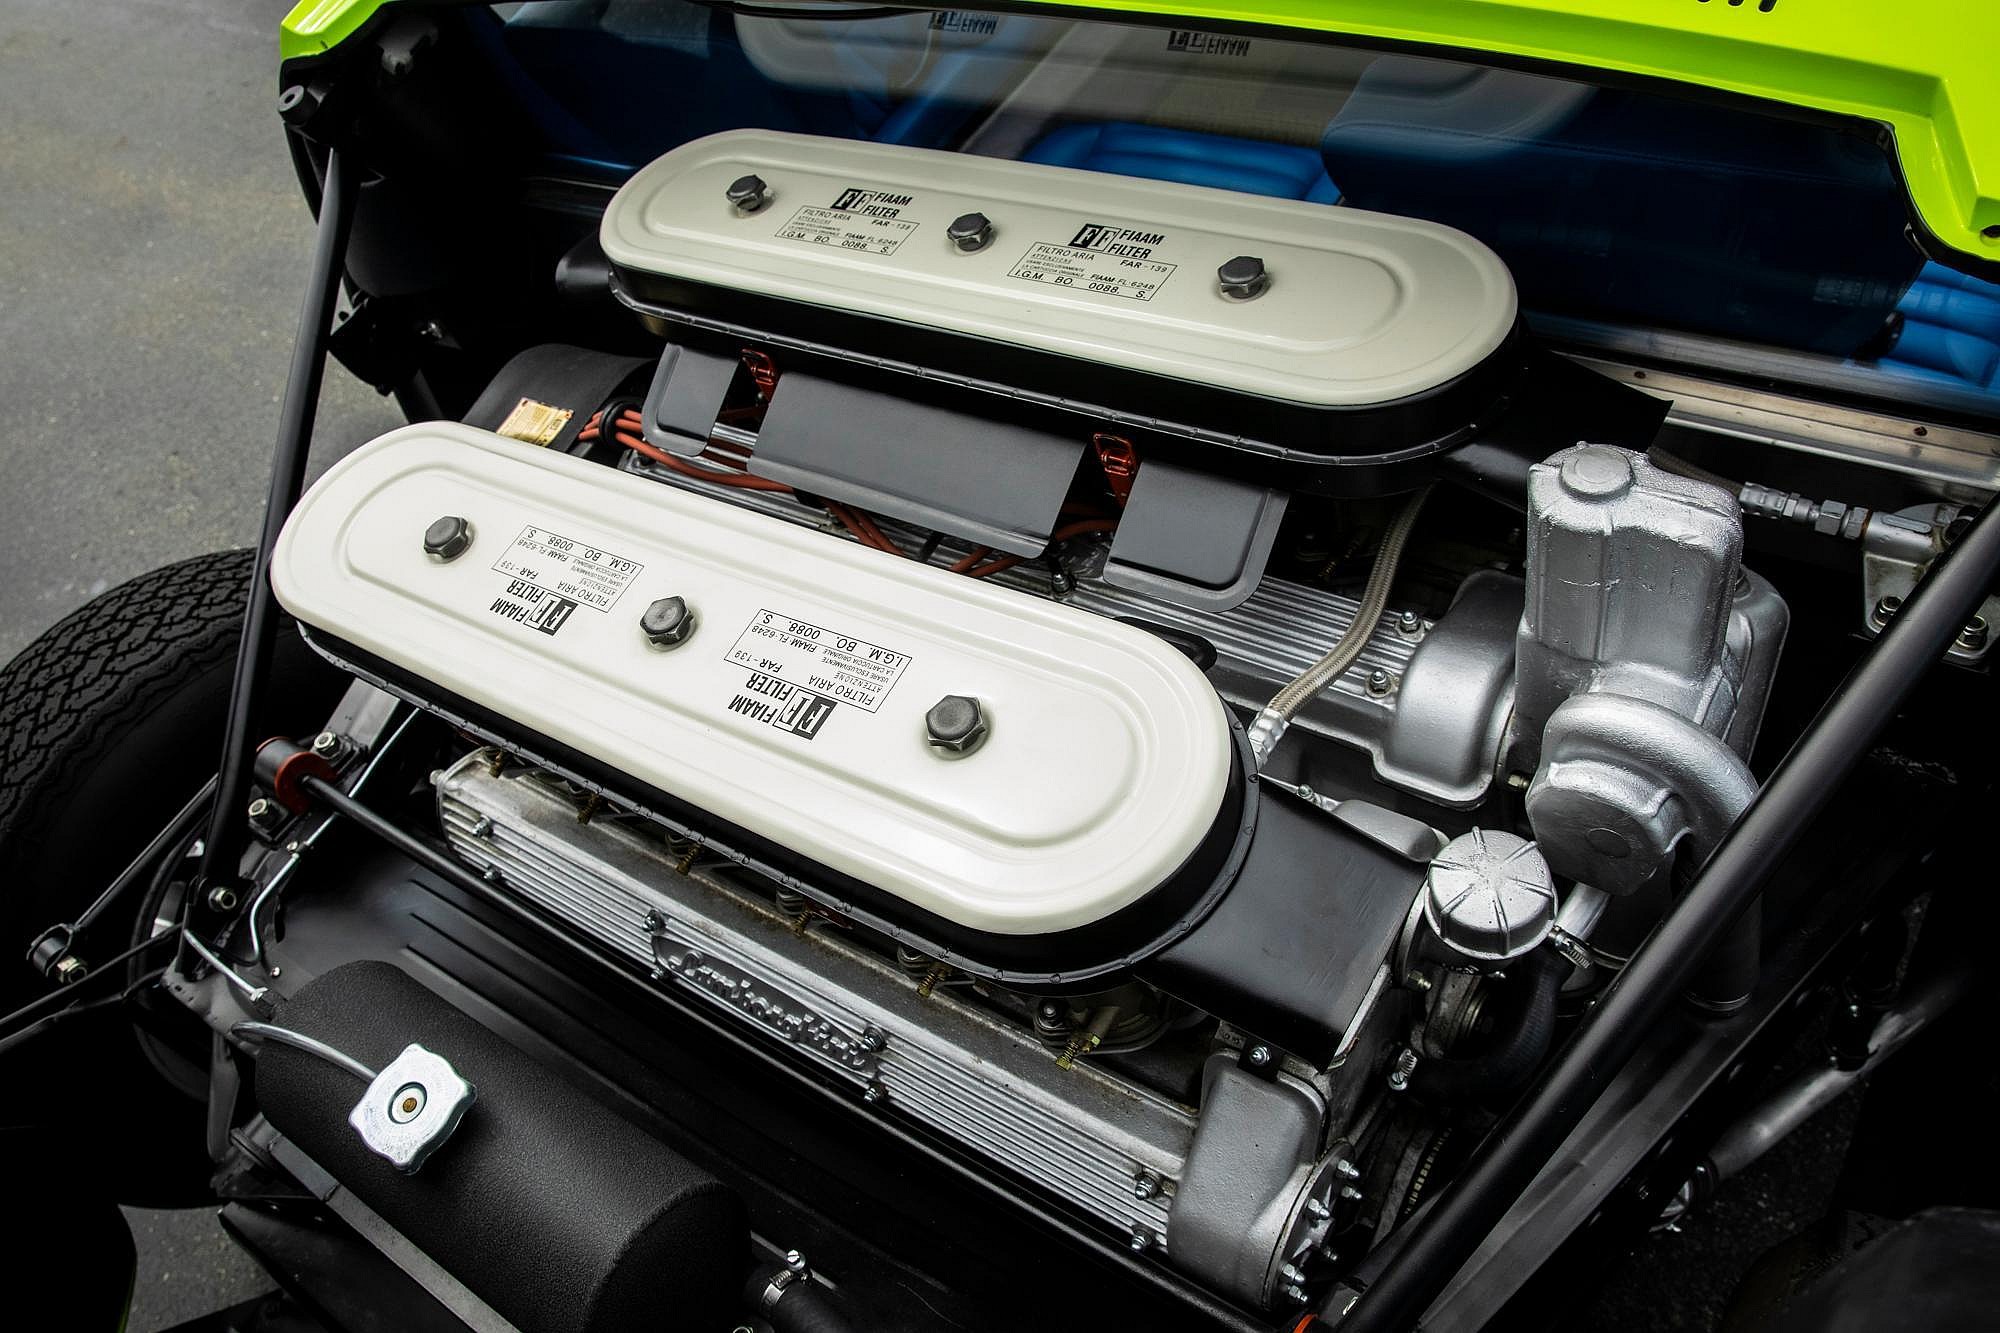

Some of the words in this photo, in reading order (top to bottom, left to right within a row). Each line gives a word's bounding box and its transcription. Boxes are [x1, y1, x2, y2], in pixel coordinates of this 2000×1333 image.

[874, 192, 913, 206] FIAAM
[803, 209, 834, 218] FILTRO
[832, 213, 852, 221] ARIA
[862, 205, 900, 219] FILTER
[1119, 229, 1165, 246] FIAAM
[1036, 245, 1072, 257] FILTRO
[1071, 251, 1095, 260] ARIA
[1107, 243, 1152, 259] FILTER
[1014, 269, 1045, 281] I.G.M.
[1054, 276, 1075, 286] BO.
[1088, 282, 1121, 294] 0088.
[1135, 291, 1147, 299] S.
[1090, 274, 1116, 283] FIAAM
[526, 528, 537, 538] S.
[547, 535, 574, 551] 0088.
[547, 550, 569, 562] FIAAM
[583, 548, 602, 562] BO.
[608, 557, 638, 574] I.G.M.
[506, 579, 545, 603] FILTER
[557, 580, 578, 594] ARIA
[577, 588, 609, 607] FILTRO
[489, 597, 529, 623] FIAAM
[761, 612, 774, 624] S.
[786, 621, 821, 640] 0088.
[790, 638, 818, 653] FIAAM
[834, 636, 858, 653] BO.
[867, 646, 904, 668] I.G.M.
[852, 658, 886, 673] CARTUCCIA
[807, 674, 835, 692] ARIA
[833, 671, 883, 694] ATTENZIONE
[869, 672, 889, 683] USARE
[745, 672, 794, 702] FILTER
[834, 684, 875, 706] FILTRO
[727, 693, 778, 724] FIAAM
